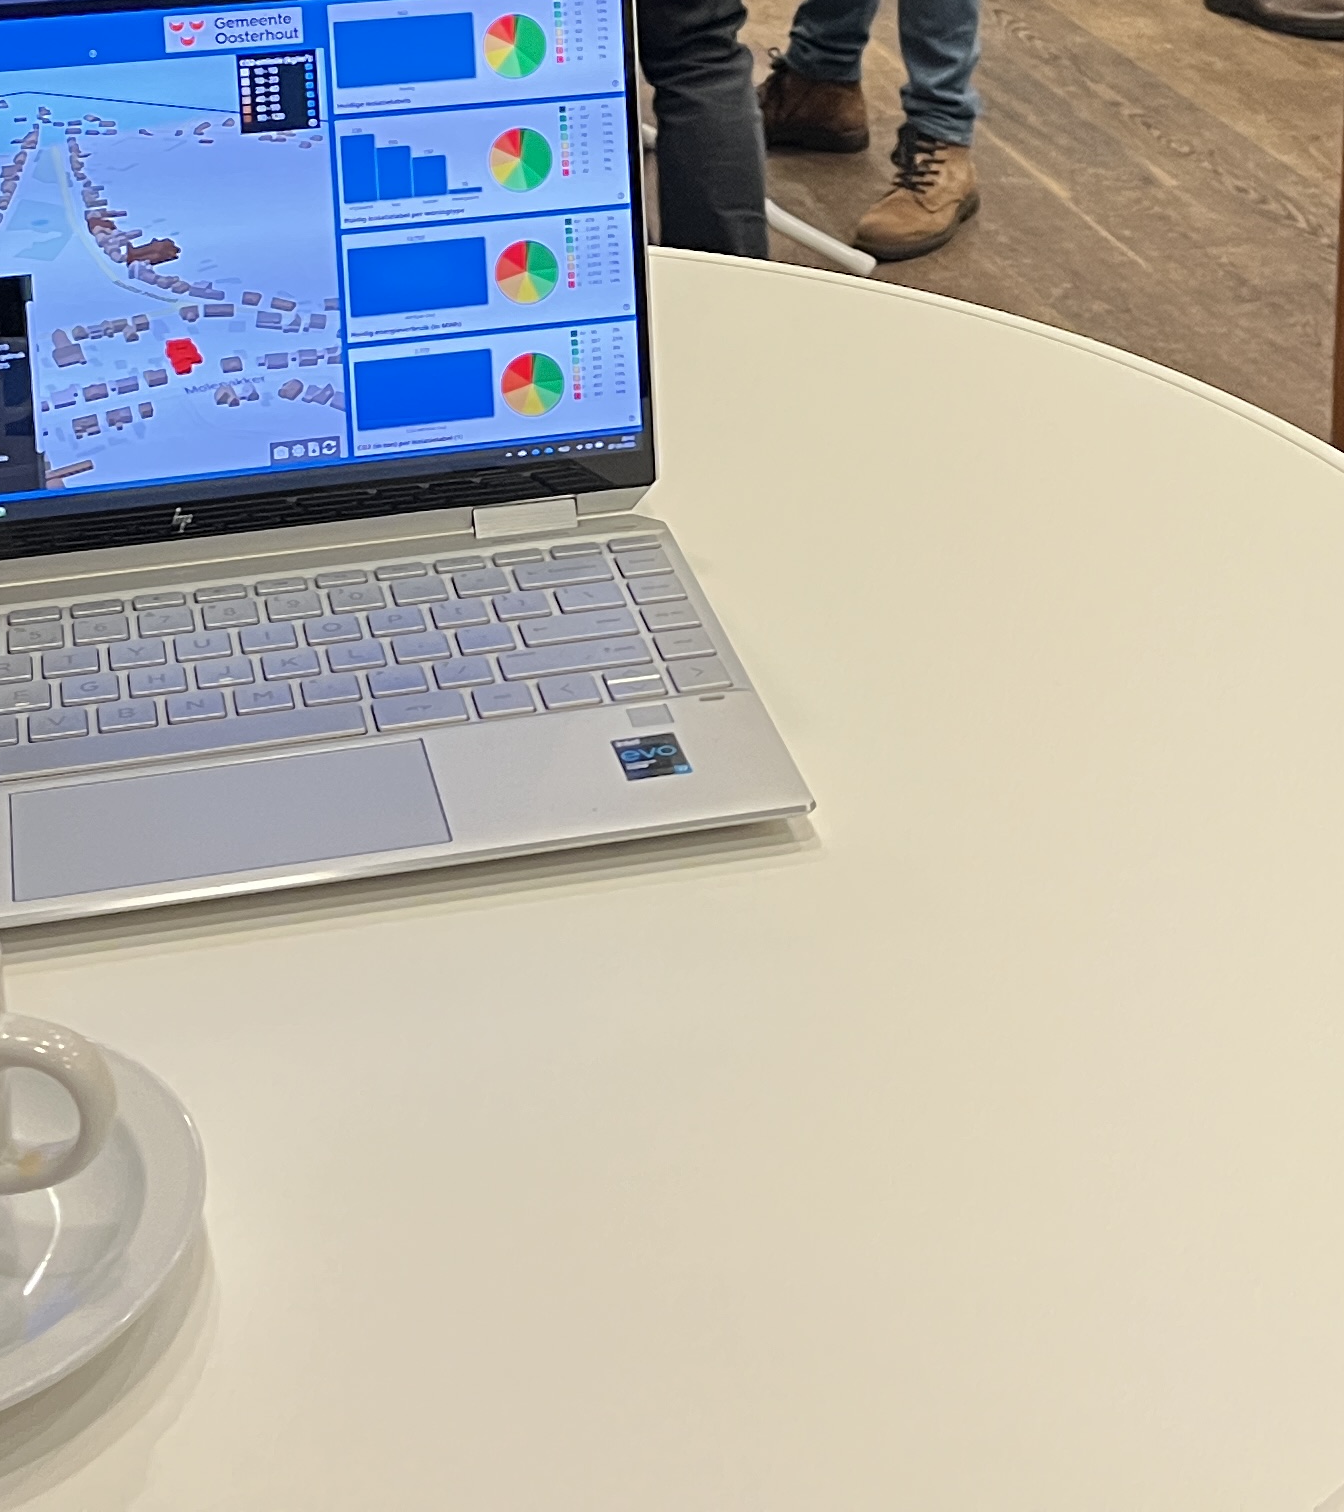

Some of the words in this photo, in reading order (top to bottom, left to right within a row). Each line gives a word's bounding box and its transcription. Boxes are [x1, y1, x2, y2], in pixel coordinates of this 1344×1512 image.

[214, 13, 292, 29] Gemeente
[215, 28, 299, 44] Oosterhout
[62, 654, 79, 665] T
[126, 646, 145, 656] Y
[193, 638, 211, 649] U
[388, 614, 404, 624] P
[80, 680, 99, 692] G
[147, 674, 166, 683] H
[280, 657, 300, 667] K
[47, 716, 65, 726] V
[118, 708, 136, 718] B
[185, 699, 204, 710] N
[253, 691, 274, 702] M
[620, 744, 677, 762] evo
